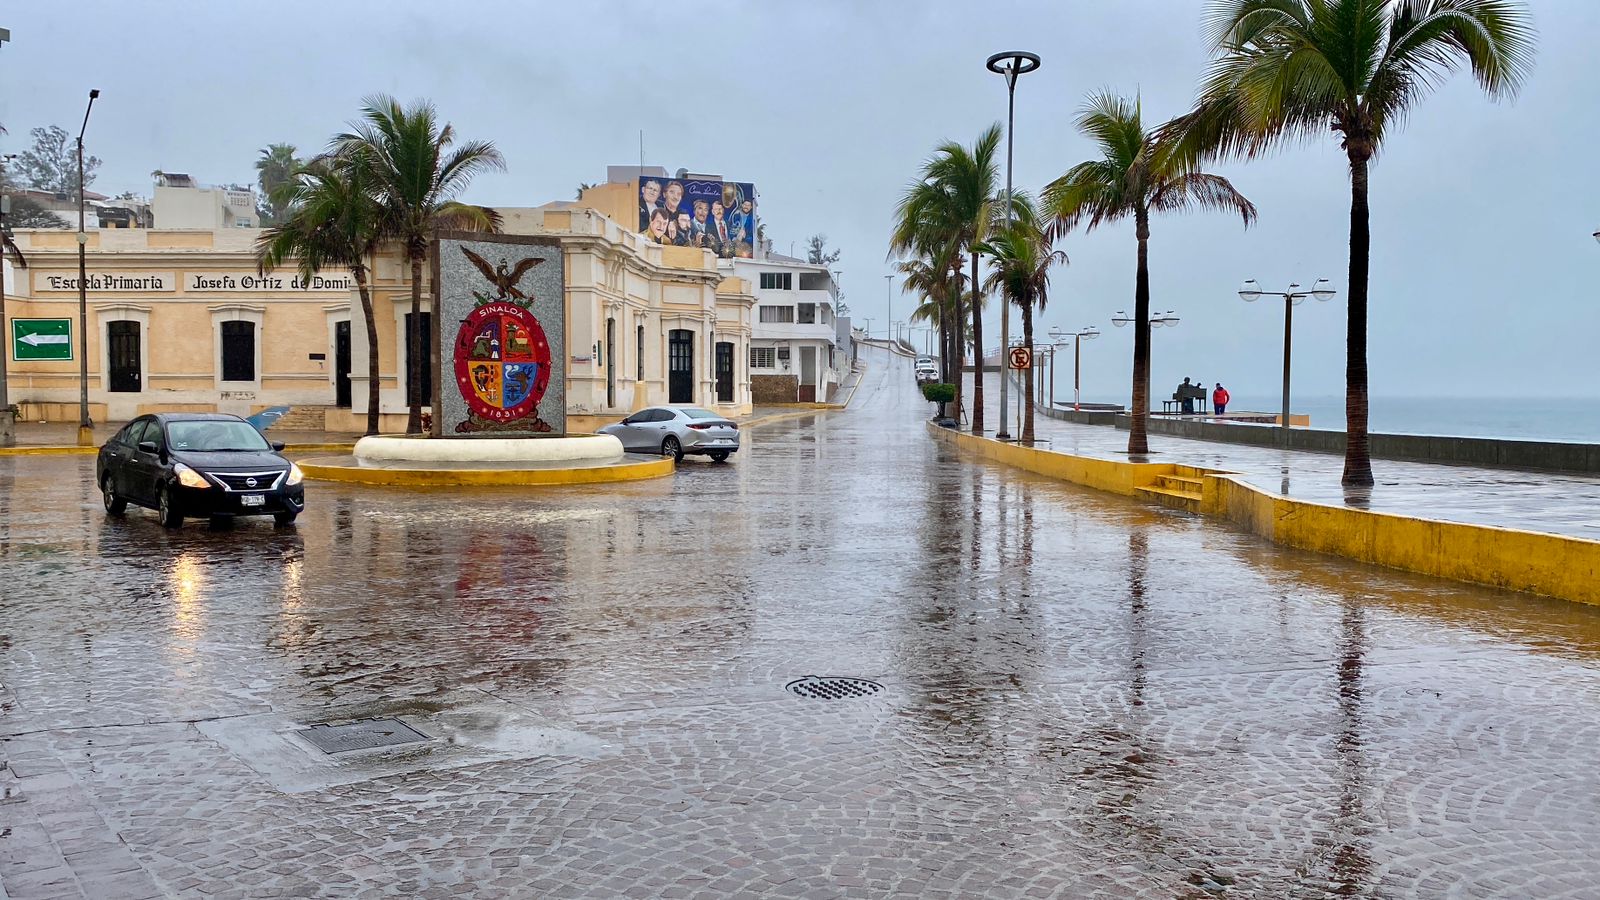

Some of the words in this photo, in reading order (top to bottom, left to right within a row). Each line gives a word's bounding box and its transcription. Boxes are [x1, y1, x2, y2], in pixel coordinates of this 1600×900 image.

[103, 274, 163, 289] Primaria
[192, 275, 236, 289] Josefa
[241, 275, 282, 289] Ortiz
[291, 275, 306, 289] de
[312, 276, 351, 289] Domi
[479, 306, 523, 319] SINALOA
[490, 408, 516, 418] 1831
